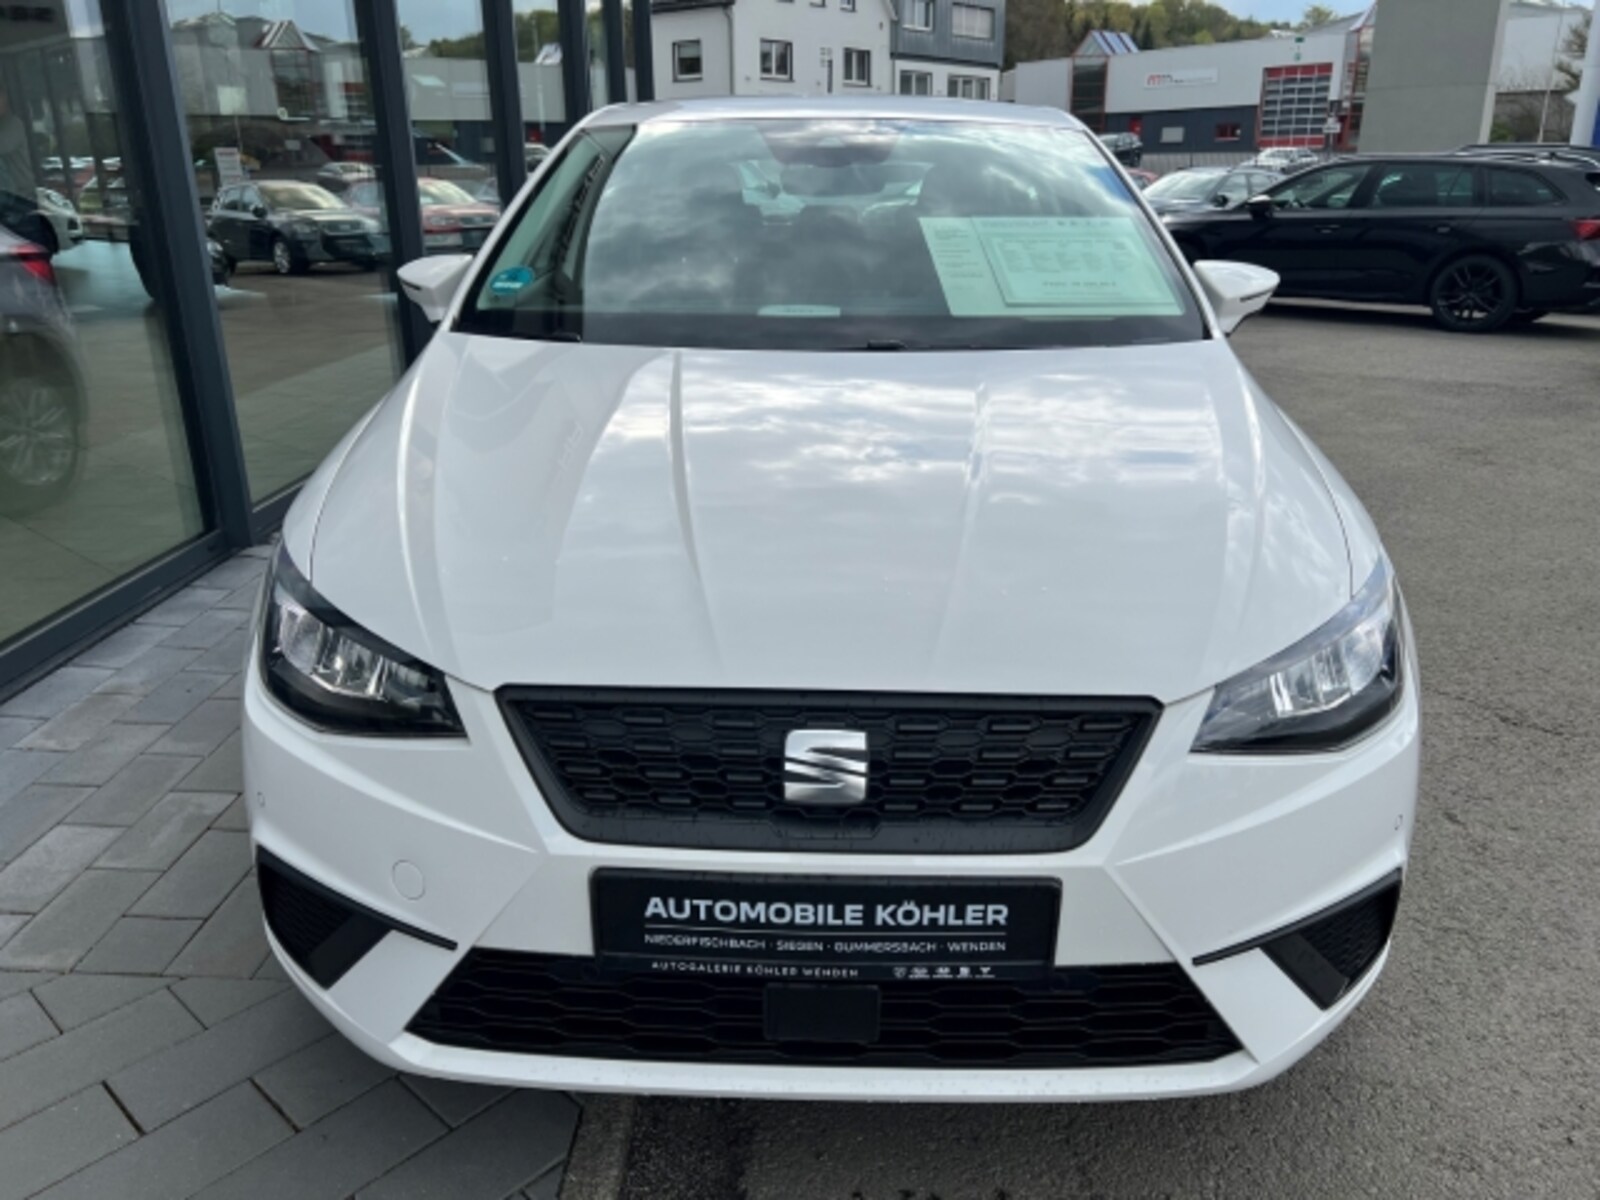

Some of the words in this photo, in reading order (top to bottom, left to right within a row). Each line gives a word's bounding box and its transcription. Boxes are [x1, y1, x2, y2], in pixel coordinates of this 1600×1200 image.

[644, 897, 864, 926] AUTOMOBILE
[875, 900, 1009, 926] KÖHLER
[644, 933, 766, 950] NIEDERFISCHBACH
[834, 941, 937, 953] GUMMERSBACH
[947, 941, 1007, 952] WENDEN
[651, 961, 742, 974] AUTOGALERIE
[746, 964, 798, 977] KÖHLER
[802, 967, 859, 978] WENDEN
